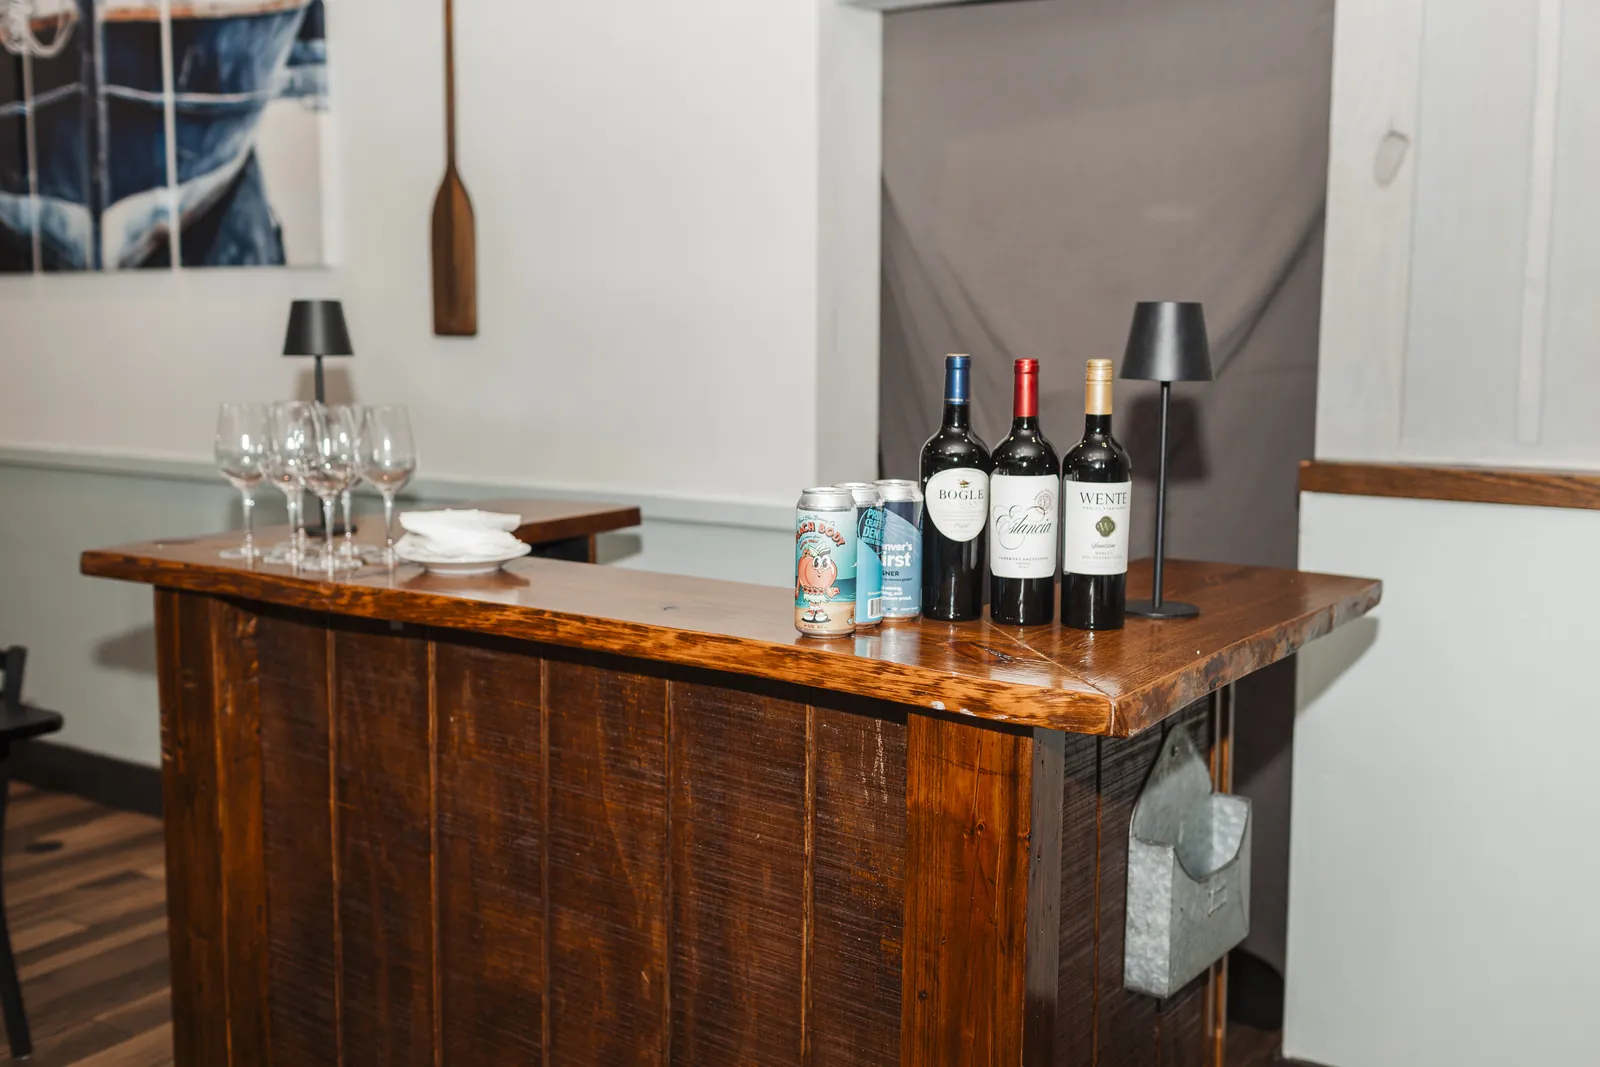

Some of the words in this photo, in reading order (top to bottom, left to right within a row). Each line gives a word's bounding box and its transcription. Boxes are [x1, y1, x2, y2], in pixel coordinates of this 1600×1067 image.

[939, 489, 984, 500] BOGLE
[1080, 492, 1127, 505] WENTE
[818, 523, 846, 547] BODY
[862, 526, 883, 541] DEN
[882, 551, 912, 567] irst
